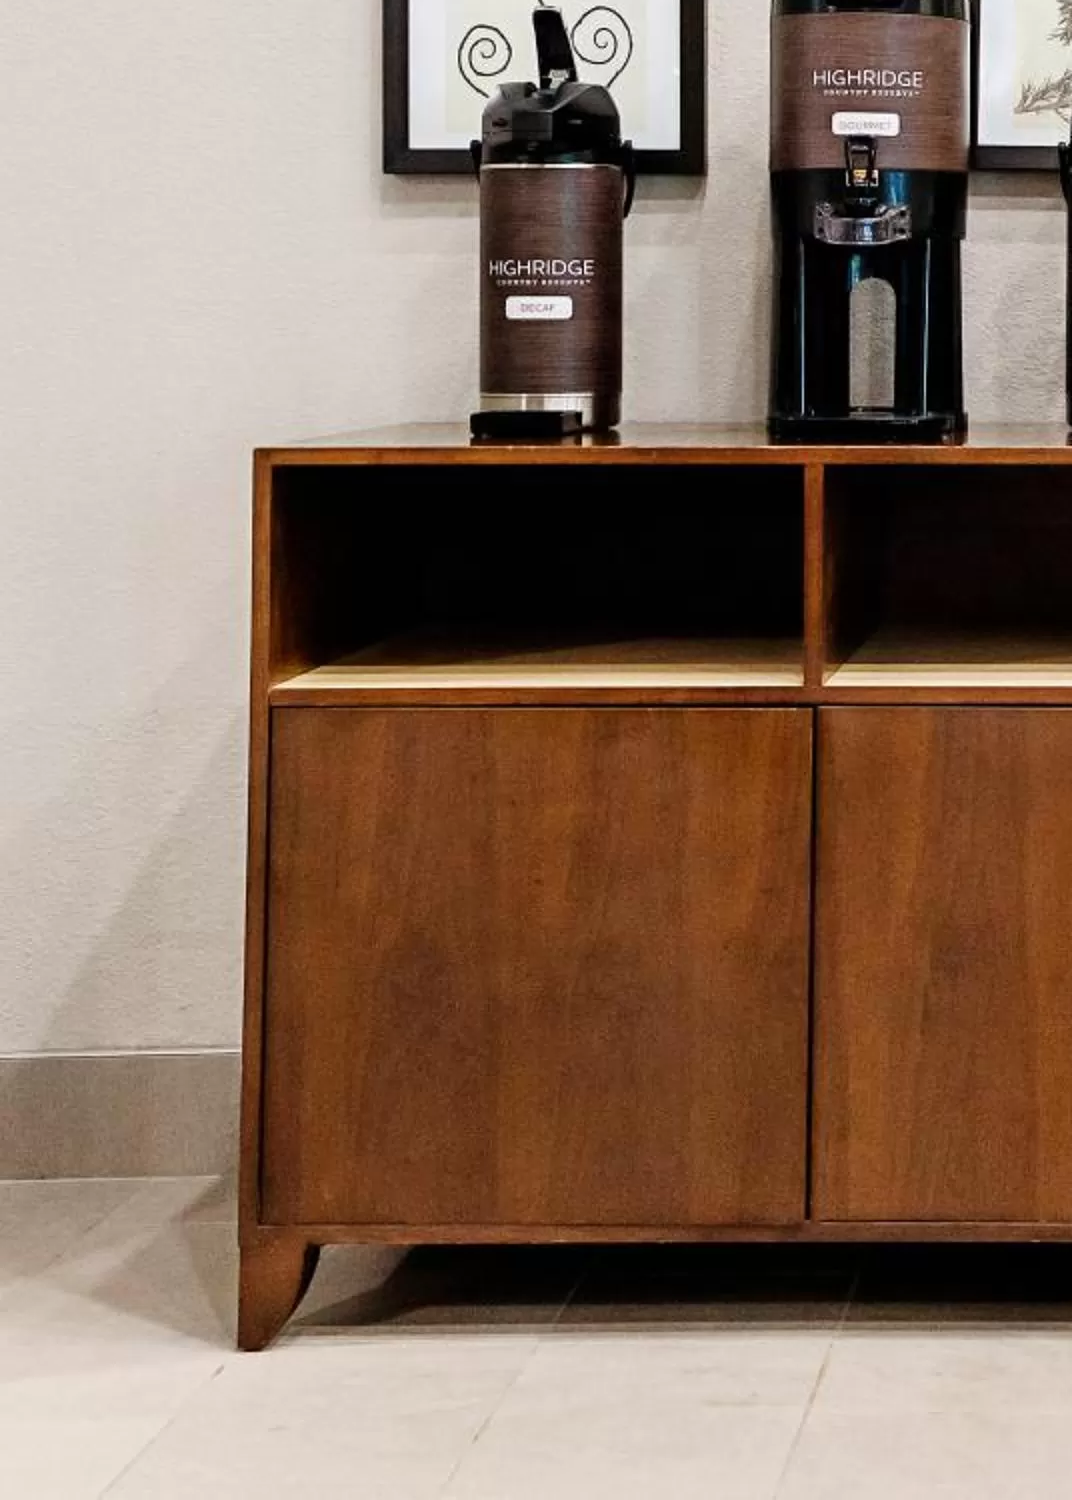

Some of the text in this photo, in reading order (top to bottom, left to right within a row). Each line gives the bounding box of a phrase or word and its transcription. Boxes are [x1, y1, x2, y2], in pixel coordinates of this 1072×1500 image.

[813, 69, 923, 88] HIGHRIDGE
[489, 259, 595, 276] HIGHRIDGE
[520, 303, 555, 313] DECAF
